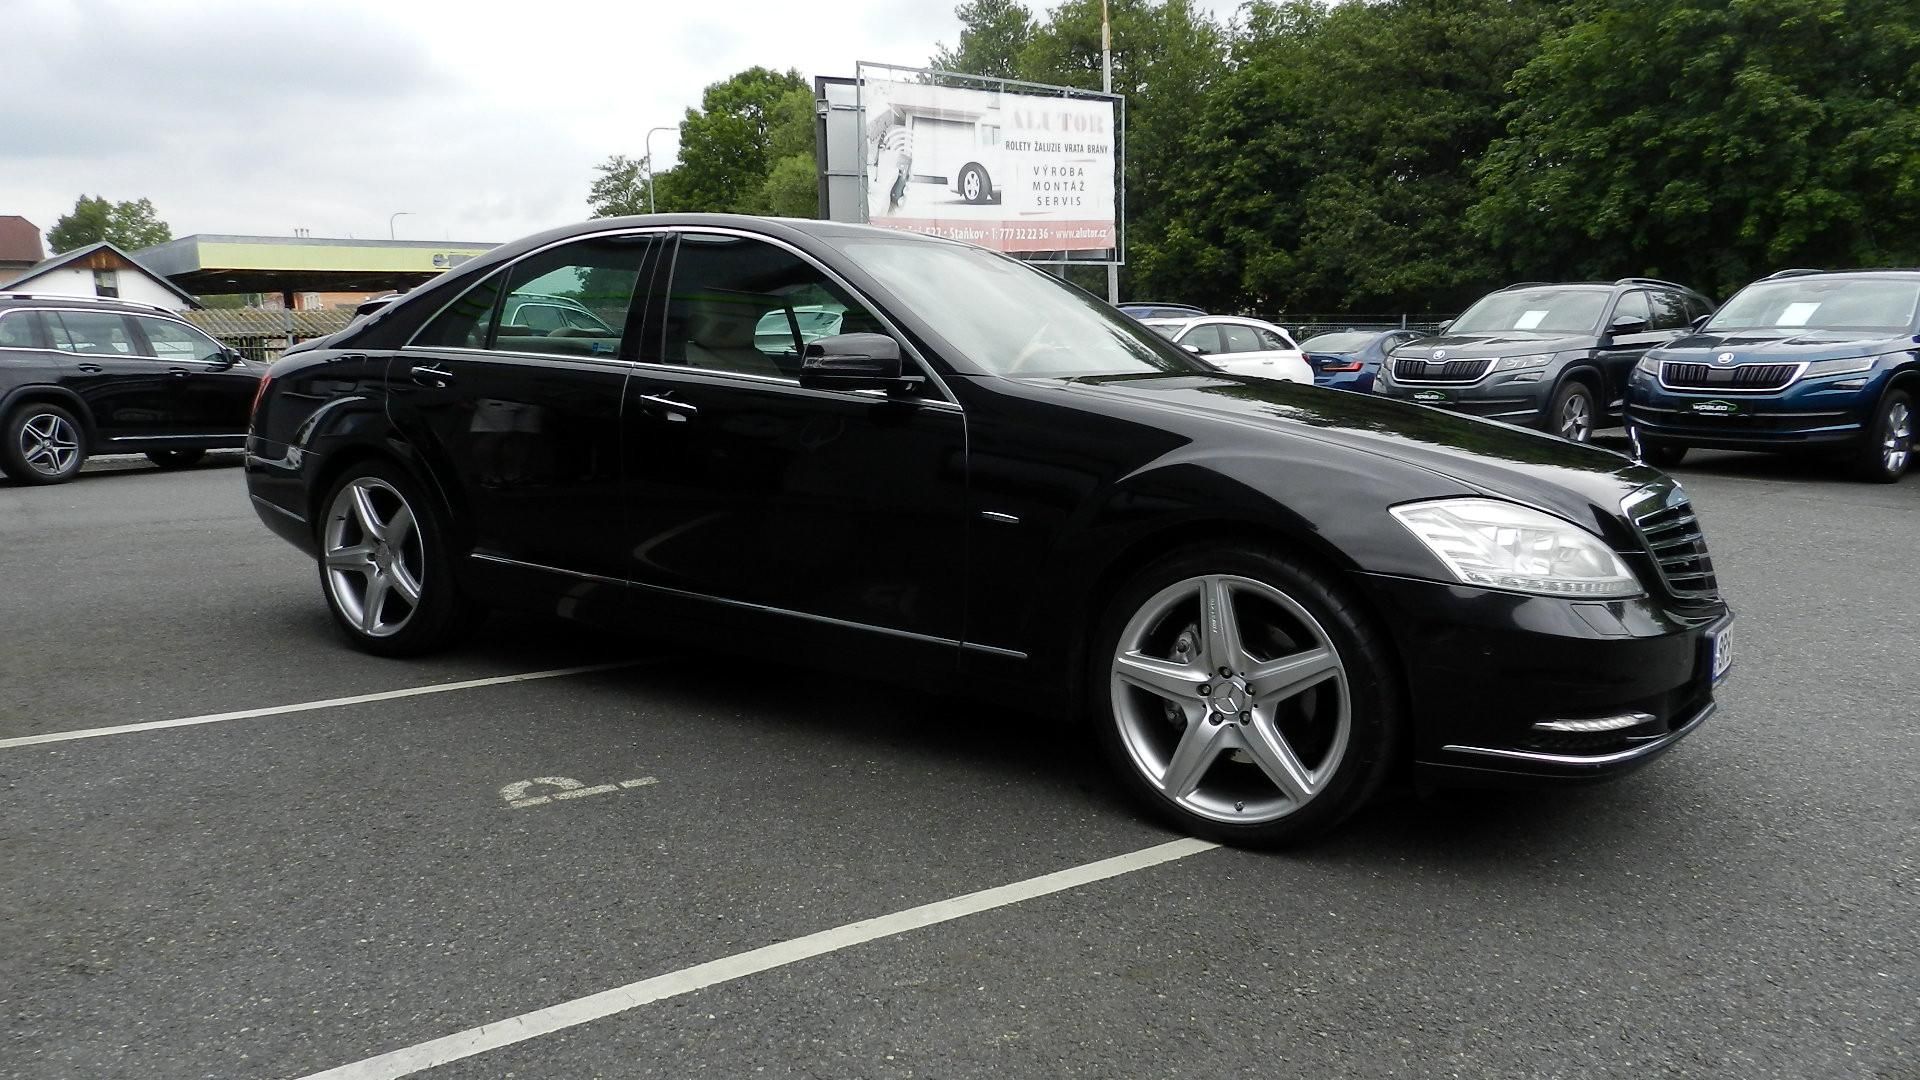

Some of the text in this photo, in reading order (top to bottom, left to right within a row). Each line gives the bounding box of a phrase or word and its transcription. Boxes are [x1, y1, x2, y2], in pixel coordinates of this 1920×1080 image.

[1011, 110, 1104, 134] ALUTOR
[1005, 140, 1109, 154] ROLETY ŽALUZIE VRATA BRÁNY
[1033, 164, 1084, 177] VÝROBA
[1032, 180, 1085, 192] MONTÁŽ
[1037, 196, 1081, 206] SERVIS
[950, 227, 984, 240] Staňkov
[1000, 227, 1014, 240] 777
[1016, 228, 1026, 240] 32
[1027, 228, 1037, 240] 22
[1039, 227, 1049, 240] 36
[1055, 227, 1107, 239] www.alutor.cz
